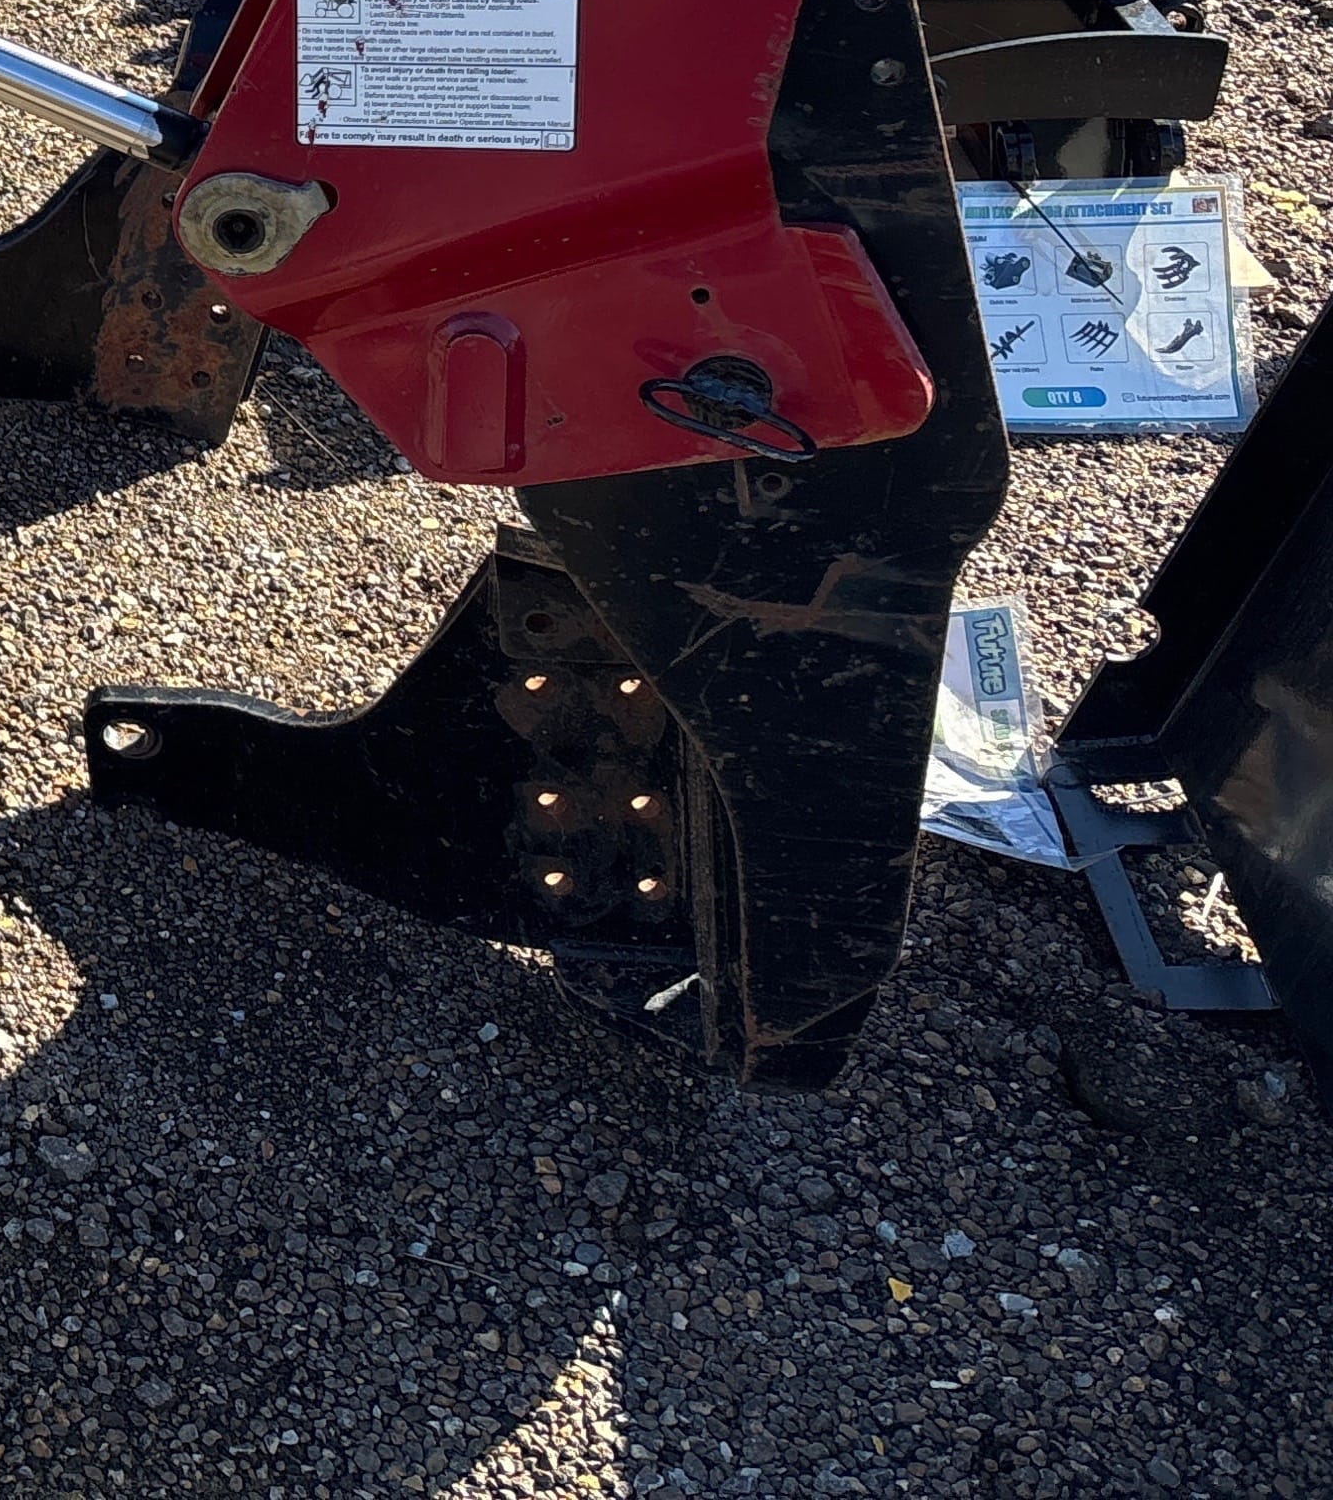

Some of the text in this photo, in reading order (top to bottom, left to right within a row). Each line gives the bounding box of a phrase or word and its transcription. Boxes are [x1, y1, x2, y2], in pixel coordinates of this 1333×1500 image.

[331, 131, 340, 139] to
[342, 131, 375, 142] comply
[377, 133, 395, 143] may
[398, 132, 424, 141] result
[426, 133, 435, 141] in
[437, 133, 463, 142] death
[477, 133, 511, 143] serious
[513, 134, 540, 145] injury
[1150, 201, 1174, 215] SET
[1047, 389, 1082, 405] QTY 8
[971, 611, 1010, 696] Future
